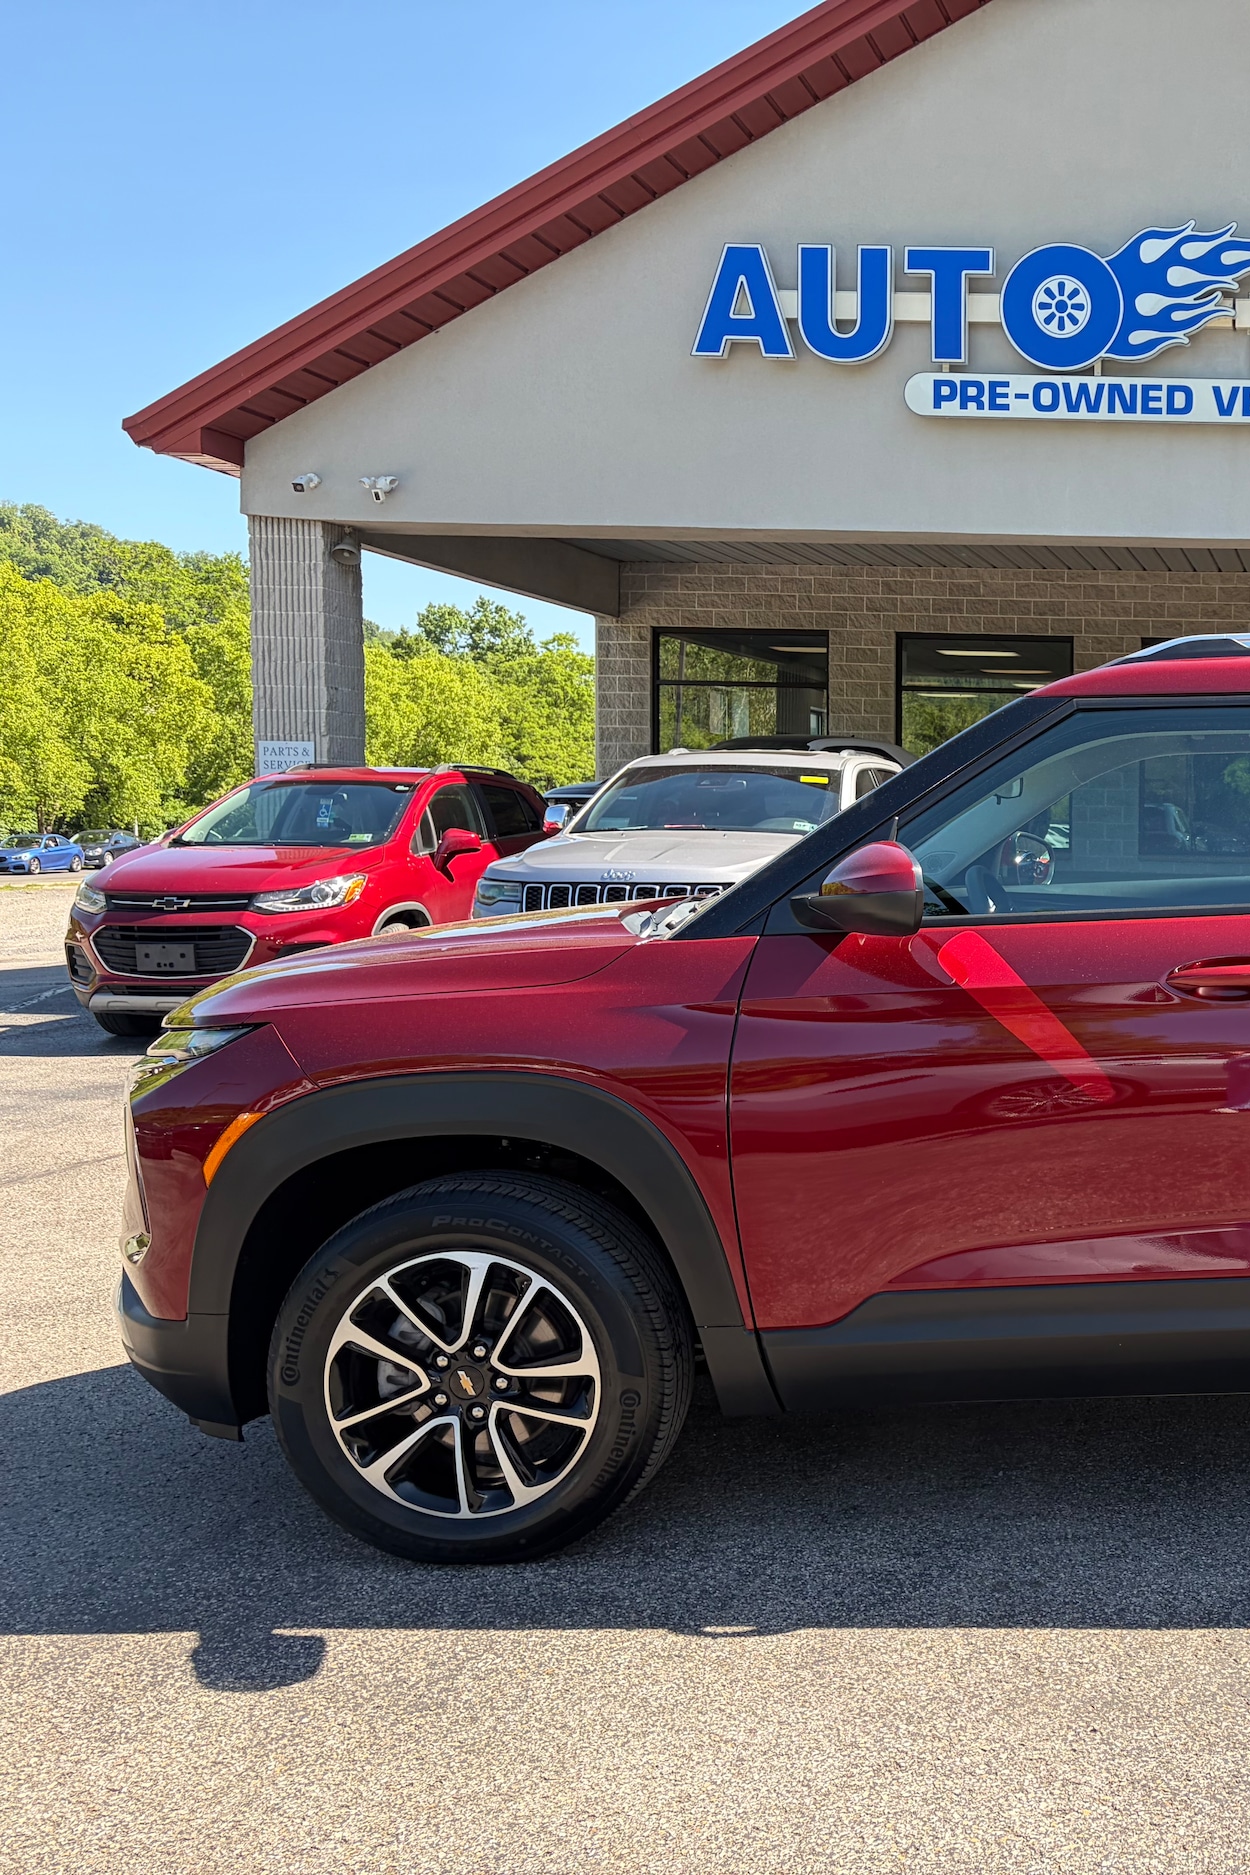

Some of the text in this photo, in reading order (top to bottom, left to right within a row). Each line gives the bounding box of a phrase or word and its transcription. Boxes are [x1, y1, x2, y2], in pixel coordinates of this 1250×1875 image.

[691, 242, 1125, 371] AUTO
[932, 379, 1194, 416] PRE-OWNED
[263, 746, 310, 757] PARTS &
[600, 868, 636, 881] Jeep
[280, 1278, 330, 1387] Continental
